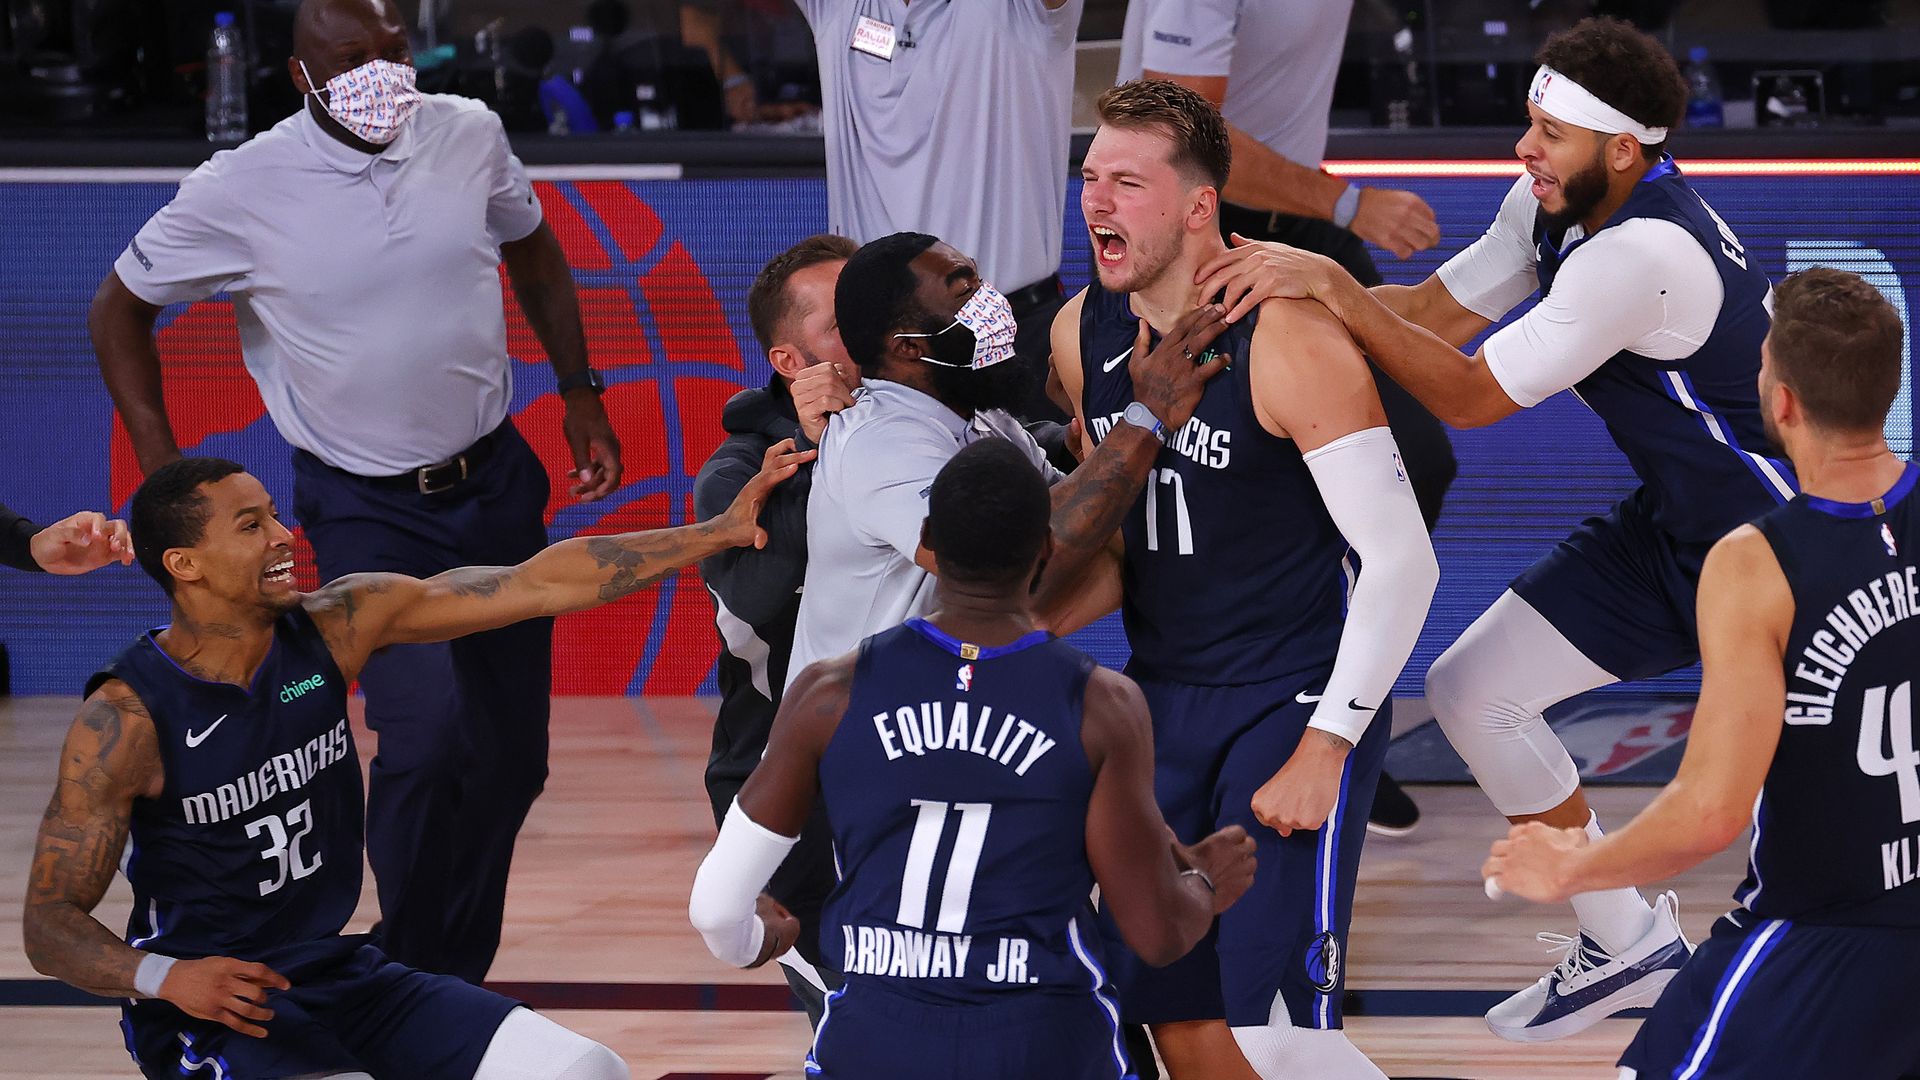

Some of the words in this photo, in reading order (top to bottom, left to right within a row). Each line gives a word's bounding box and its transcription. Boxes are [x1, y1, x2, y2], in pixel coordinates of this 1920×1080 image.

[279, 673, 326, 704] chime
[181, 718, 349, 825] MAVERICKS
[872, 700, 1057, 777] EQUALITY
[244, 798, 324, 897] 32
[895, 798, 993, 934] 11
[985, 937, 1039, 985] JR.
